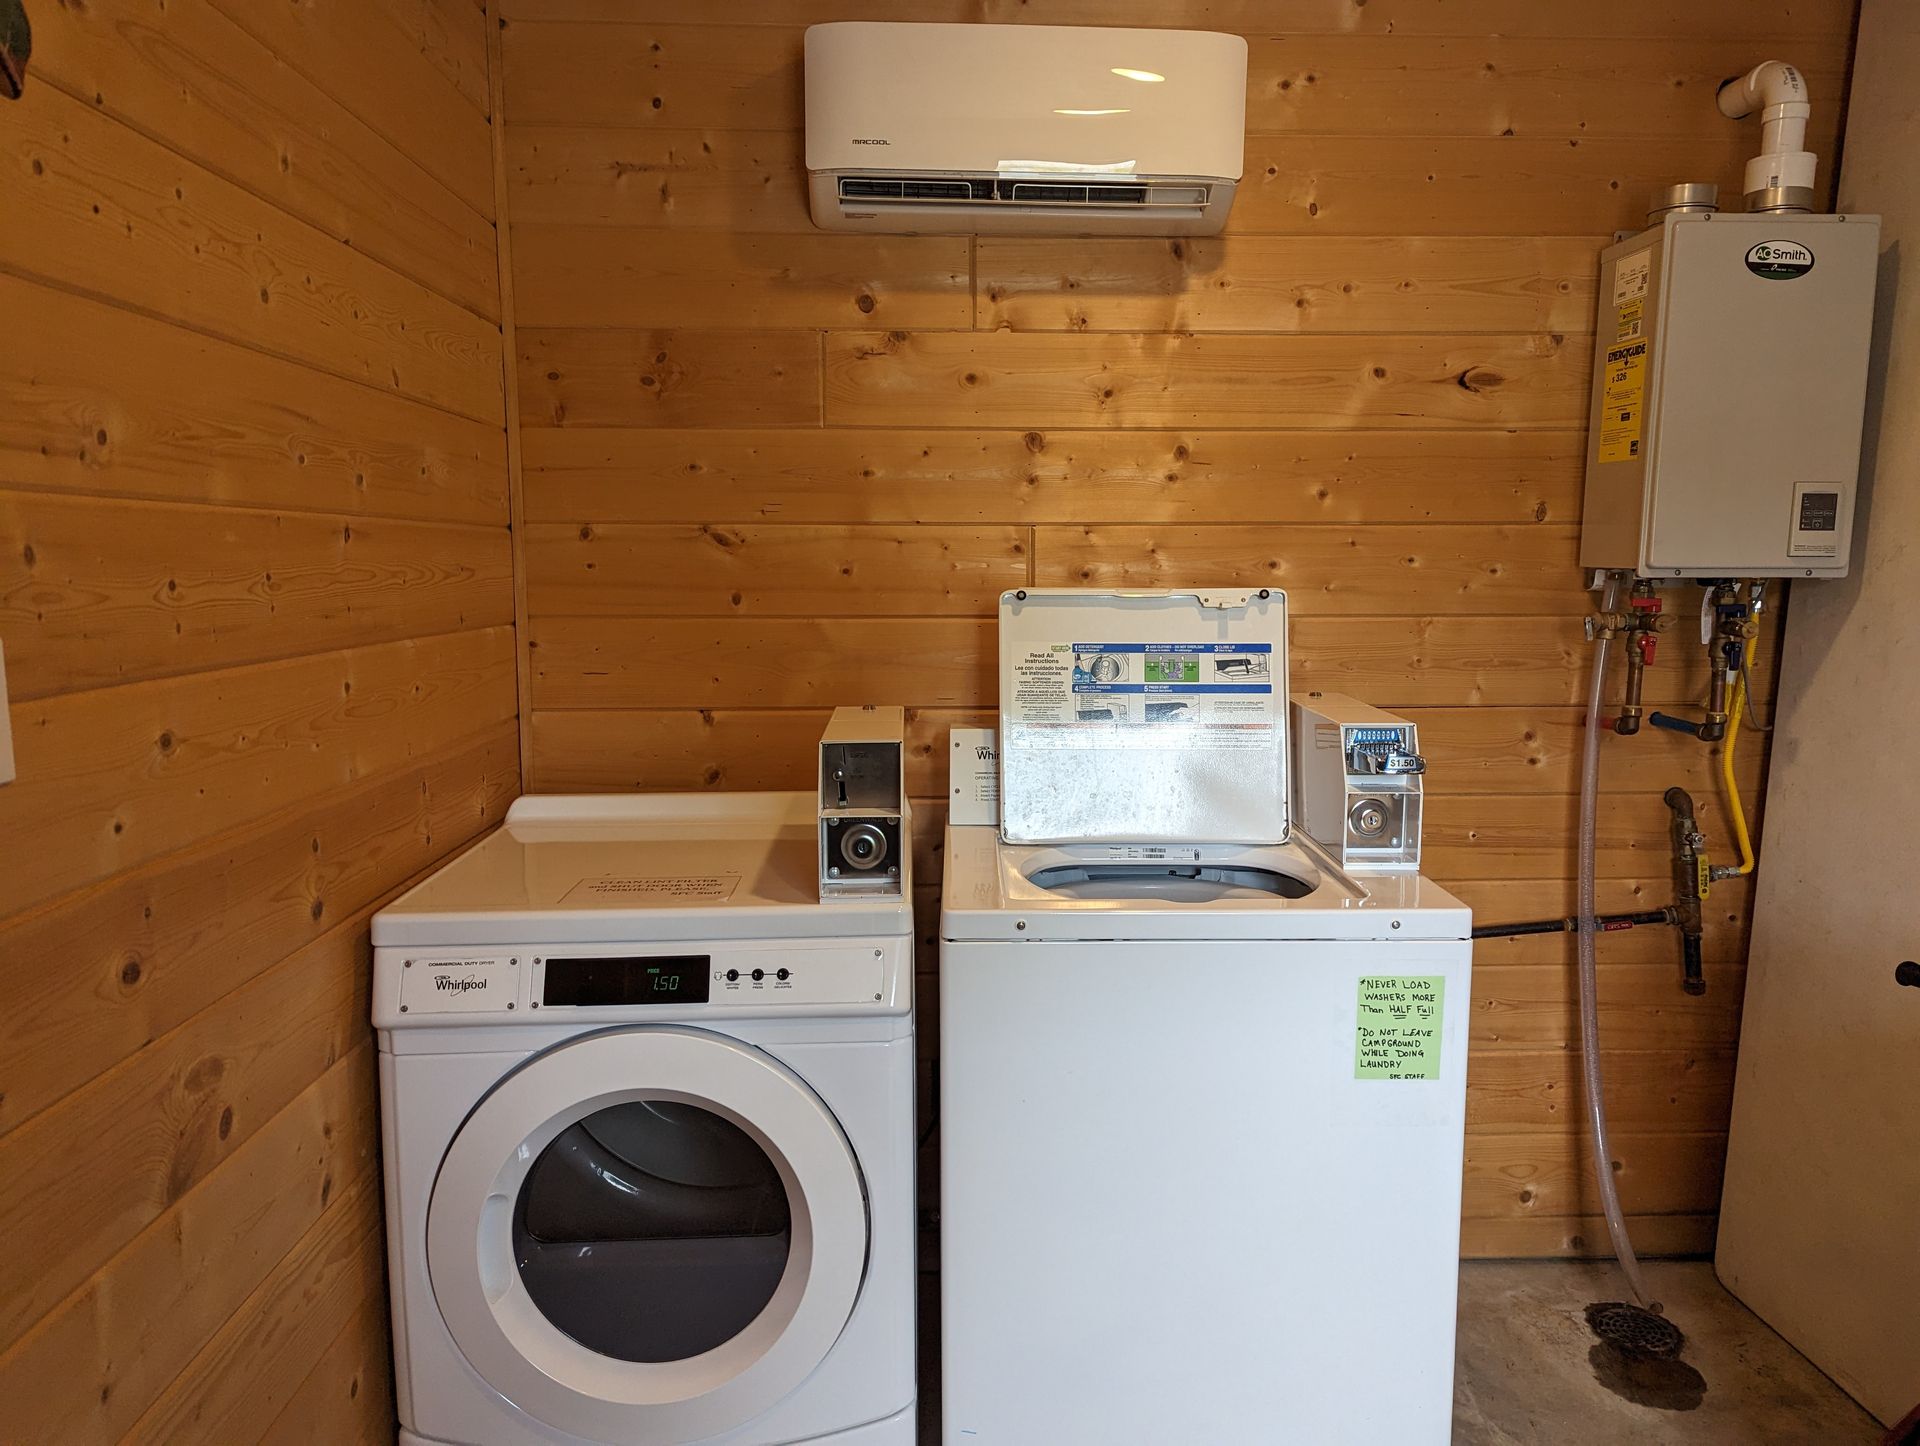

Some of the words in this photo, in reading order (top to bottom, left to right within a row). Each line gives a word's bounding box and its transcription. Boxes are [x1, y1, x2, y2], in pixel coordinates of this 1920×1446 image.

[1773, 249, 1807, 261] Smith
[1390, 759, 1415, 767] $1.50
[435, 978, 487, 992] Whirlpool
[653, 975, 679, 991] 1.50
[1402, 980, 1431, 990] LOAD
[1364, 992, 1406, 1002] WASHERS
[1412, 993, 1436, 1002] MORE
[1360, 1004, 1384, 1014] Than
[1389, 1004, 1412, 1014] HALF
[1417, 1005, 1434, 1014] Full
[1379, 1028, 1398, 1037] NOT
[1402, 1028, 1433, 1037] LEAVE
[1361, 1038, 1421, 1048] CAMPGROUND
[1361, 1048, 1389, 1057] WHILE
[1395, 1049, 1425, 1058] DOING
[1360, 1059, 1402, 1069] LAUNDRY
